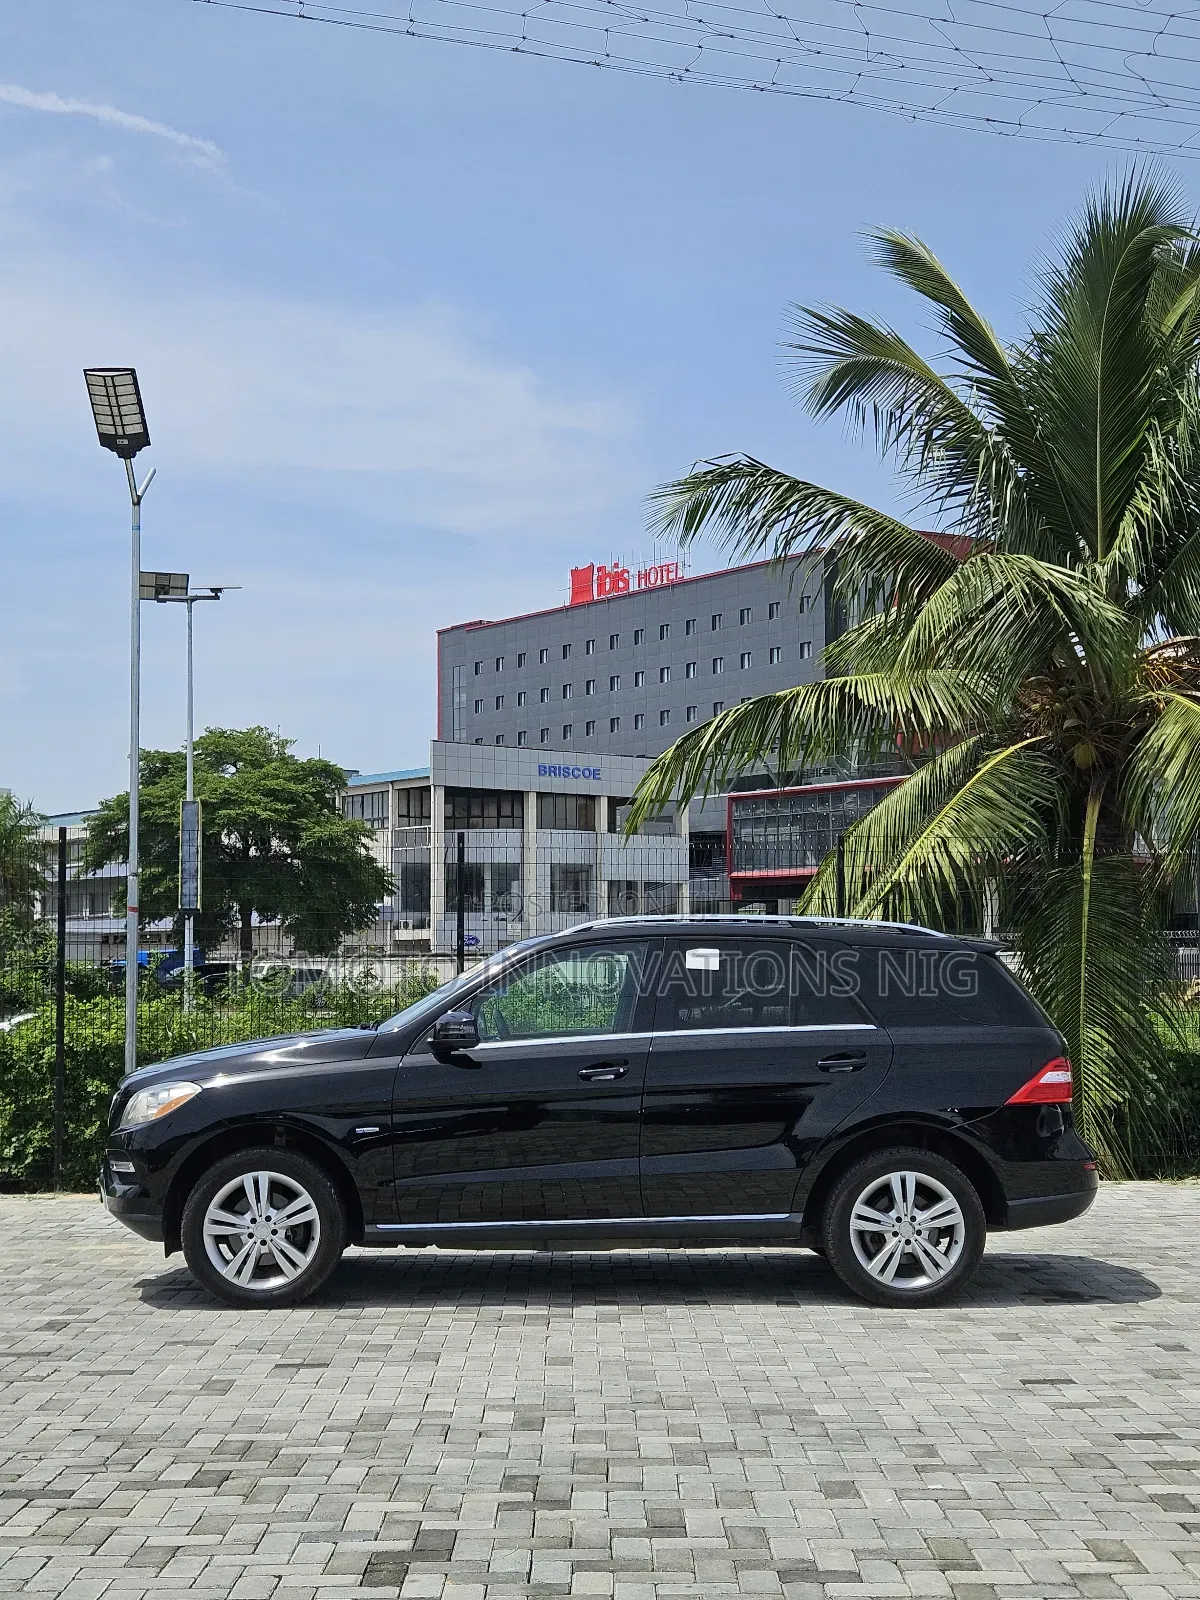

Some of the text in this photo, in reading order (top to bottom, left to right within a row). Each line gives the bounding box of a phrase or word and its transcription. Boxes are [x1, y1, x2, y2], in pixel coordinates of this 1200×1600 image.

[597, 561, 684, 597] ibis HOTEL
[538, 765, 601, 780] BRISCOE
